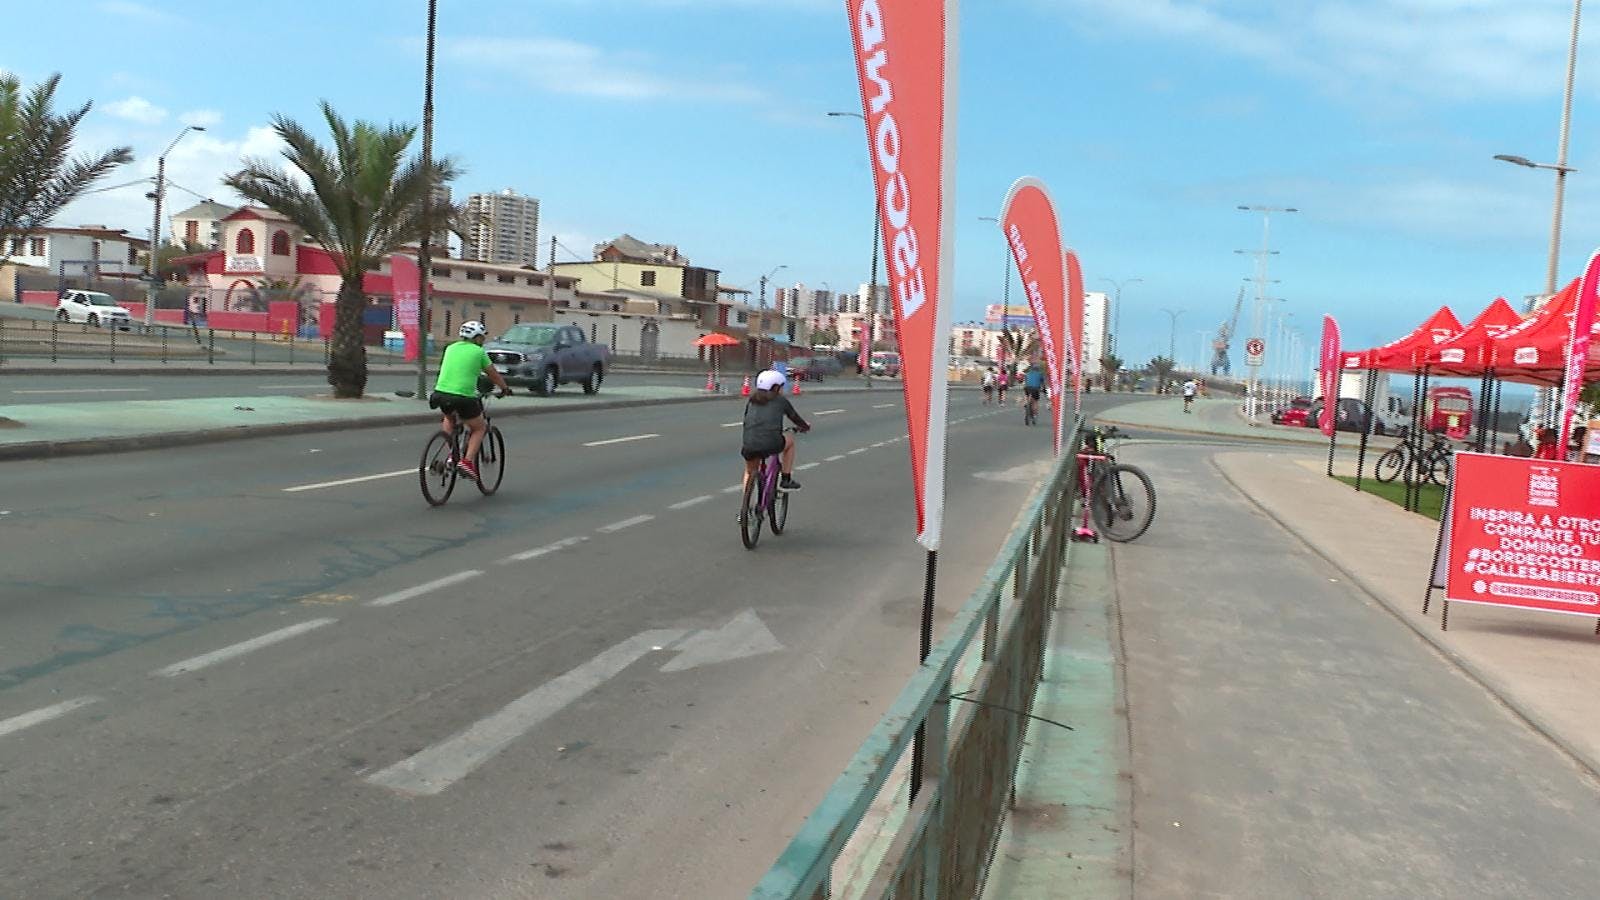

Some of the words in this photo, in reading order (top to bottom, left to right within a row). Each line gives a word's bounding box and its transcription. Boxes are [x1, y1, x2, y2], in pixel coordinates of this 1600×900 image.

[1469, 507, 1536, 525] INSPIRA
[1540, 514, 1553, 527] A
[1484, 522, 1574, 543] COMPARTE
[1580, 531, 1600, 545] TU
[1500, 538, 1583, 557] DOMINGO
